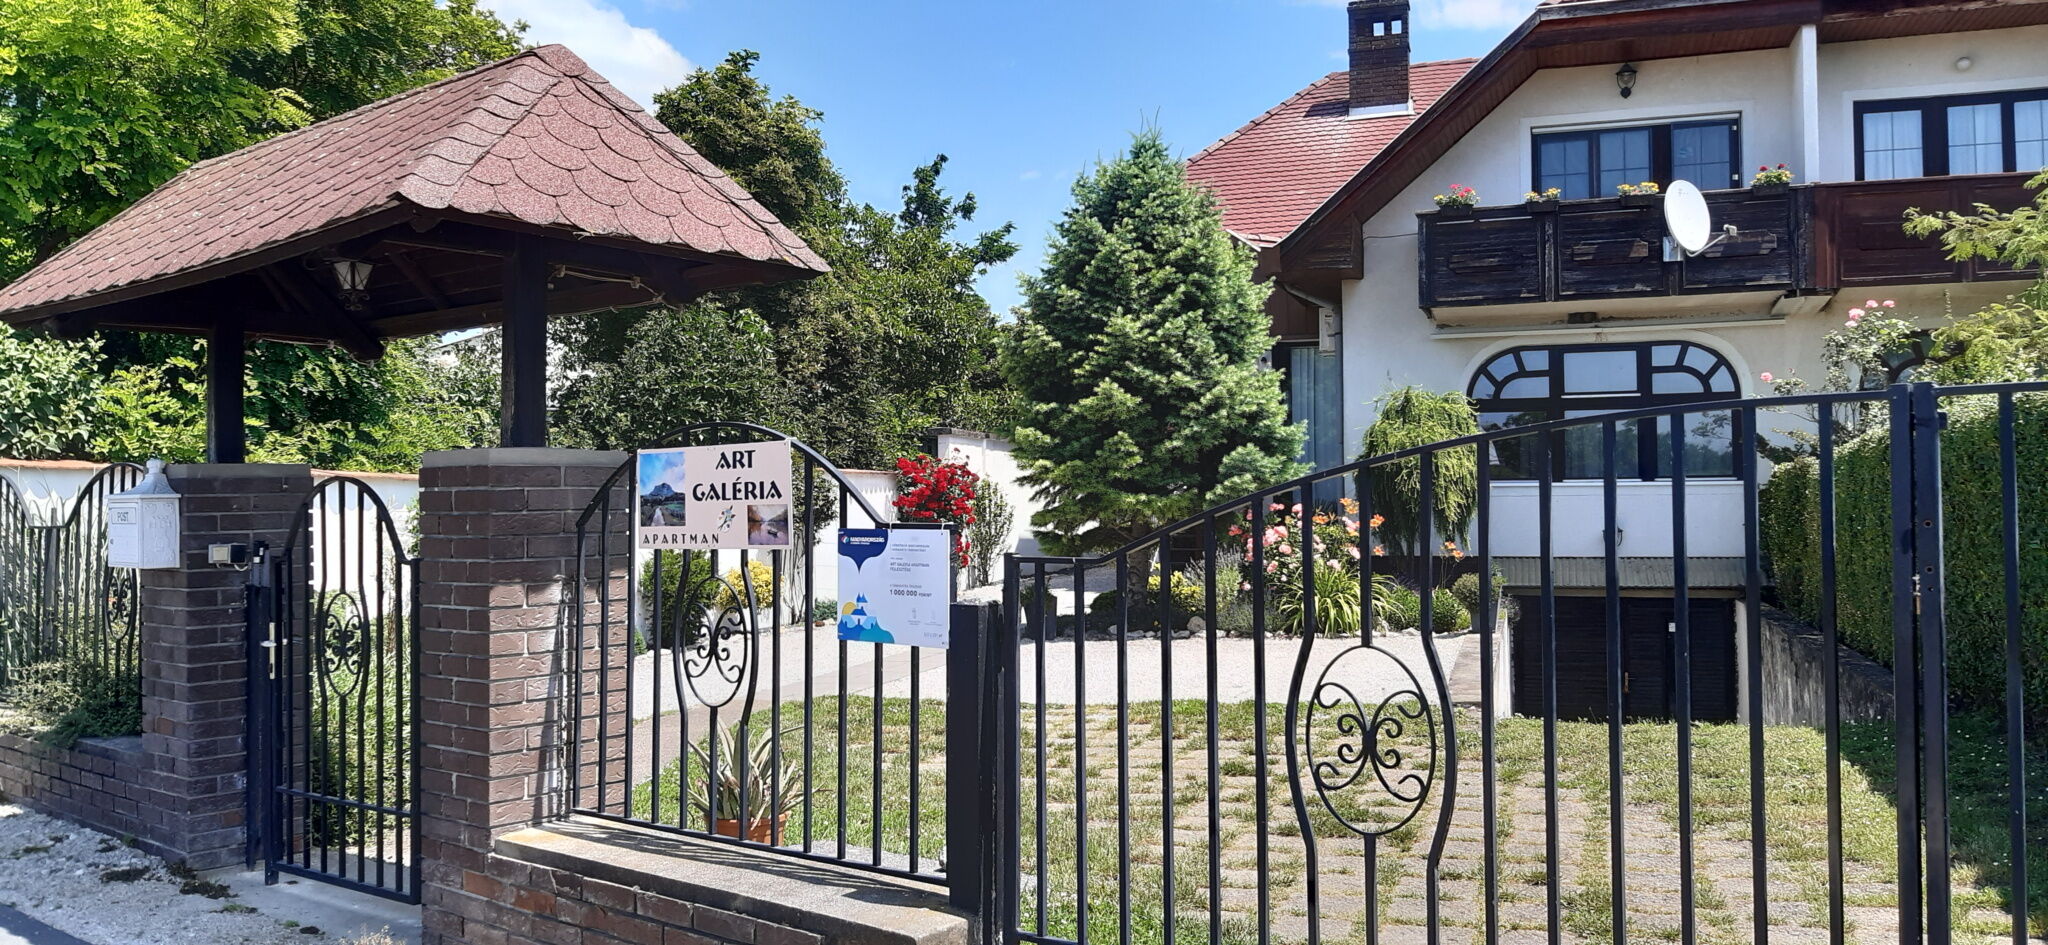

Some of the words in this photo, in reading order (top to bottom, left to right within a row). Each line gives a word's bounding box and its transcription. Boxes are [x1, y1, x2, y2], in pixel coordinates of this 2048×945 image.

[715, 450, 756, 470] ART
[692, 477, 783, 502] GALÉRIA
[642, 533, 719, 545] APARTMAN
